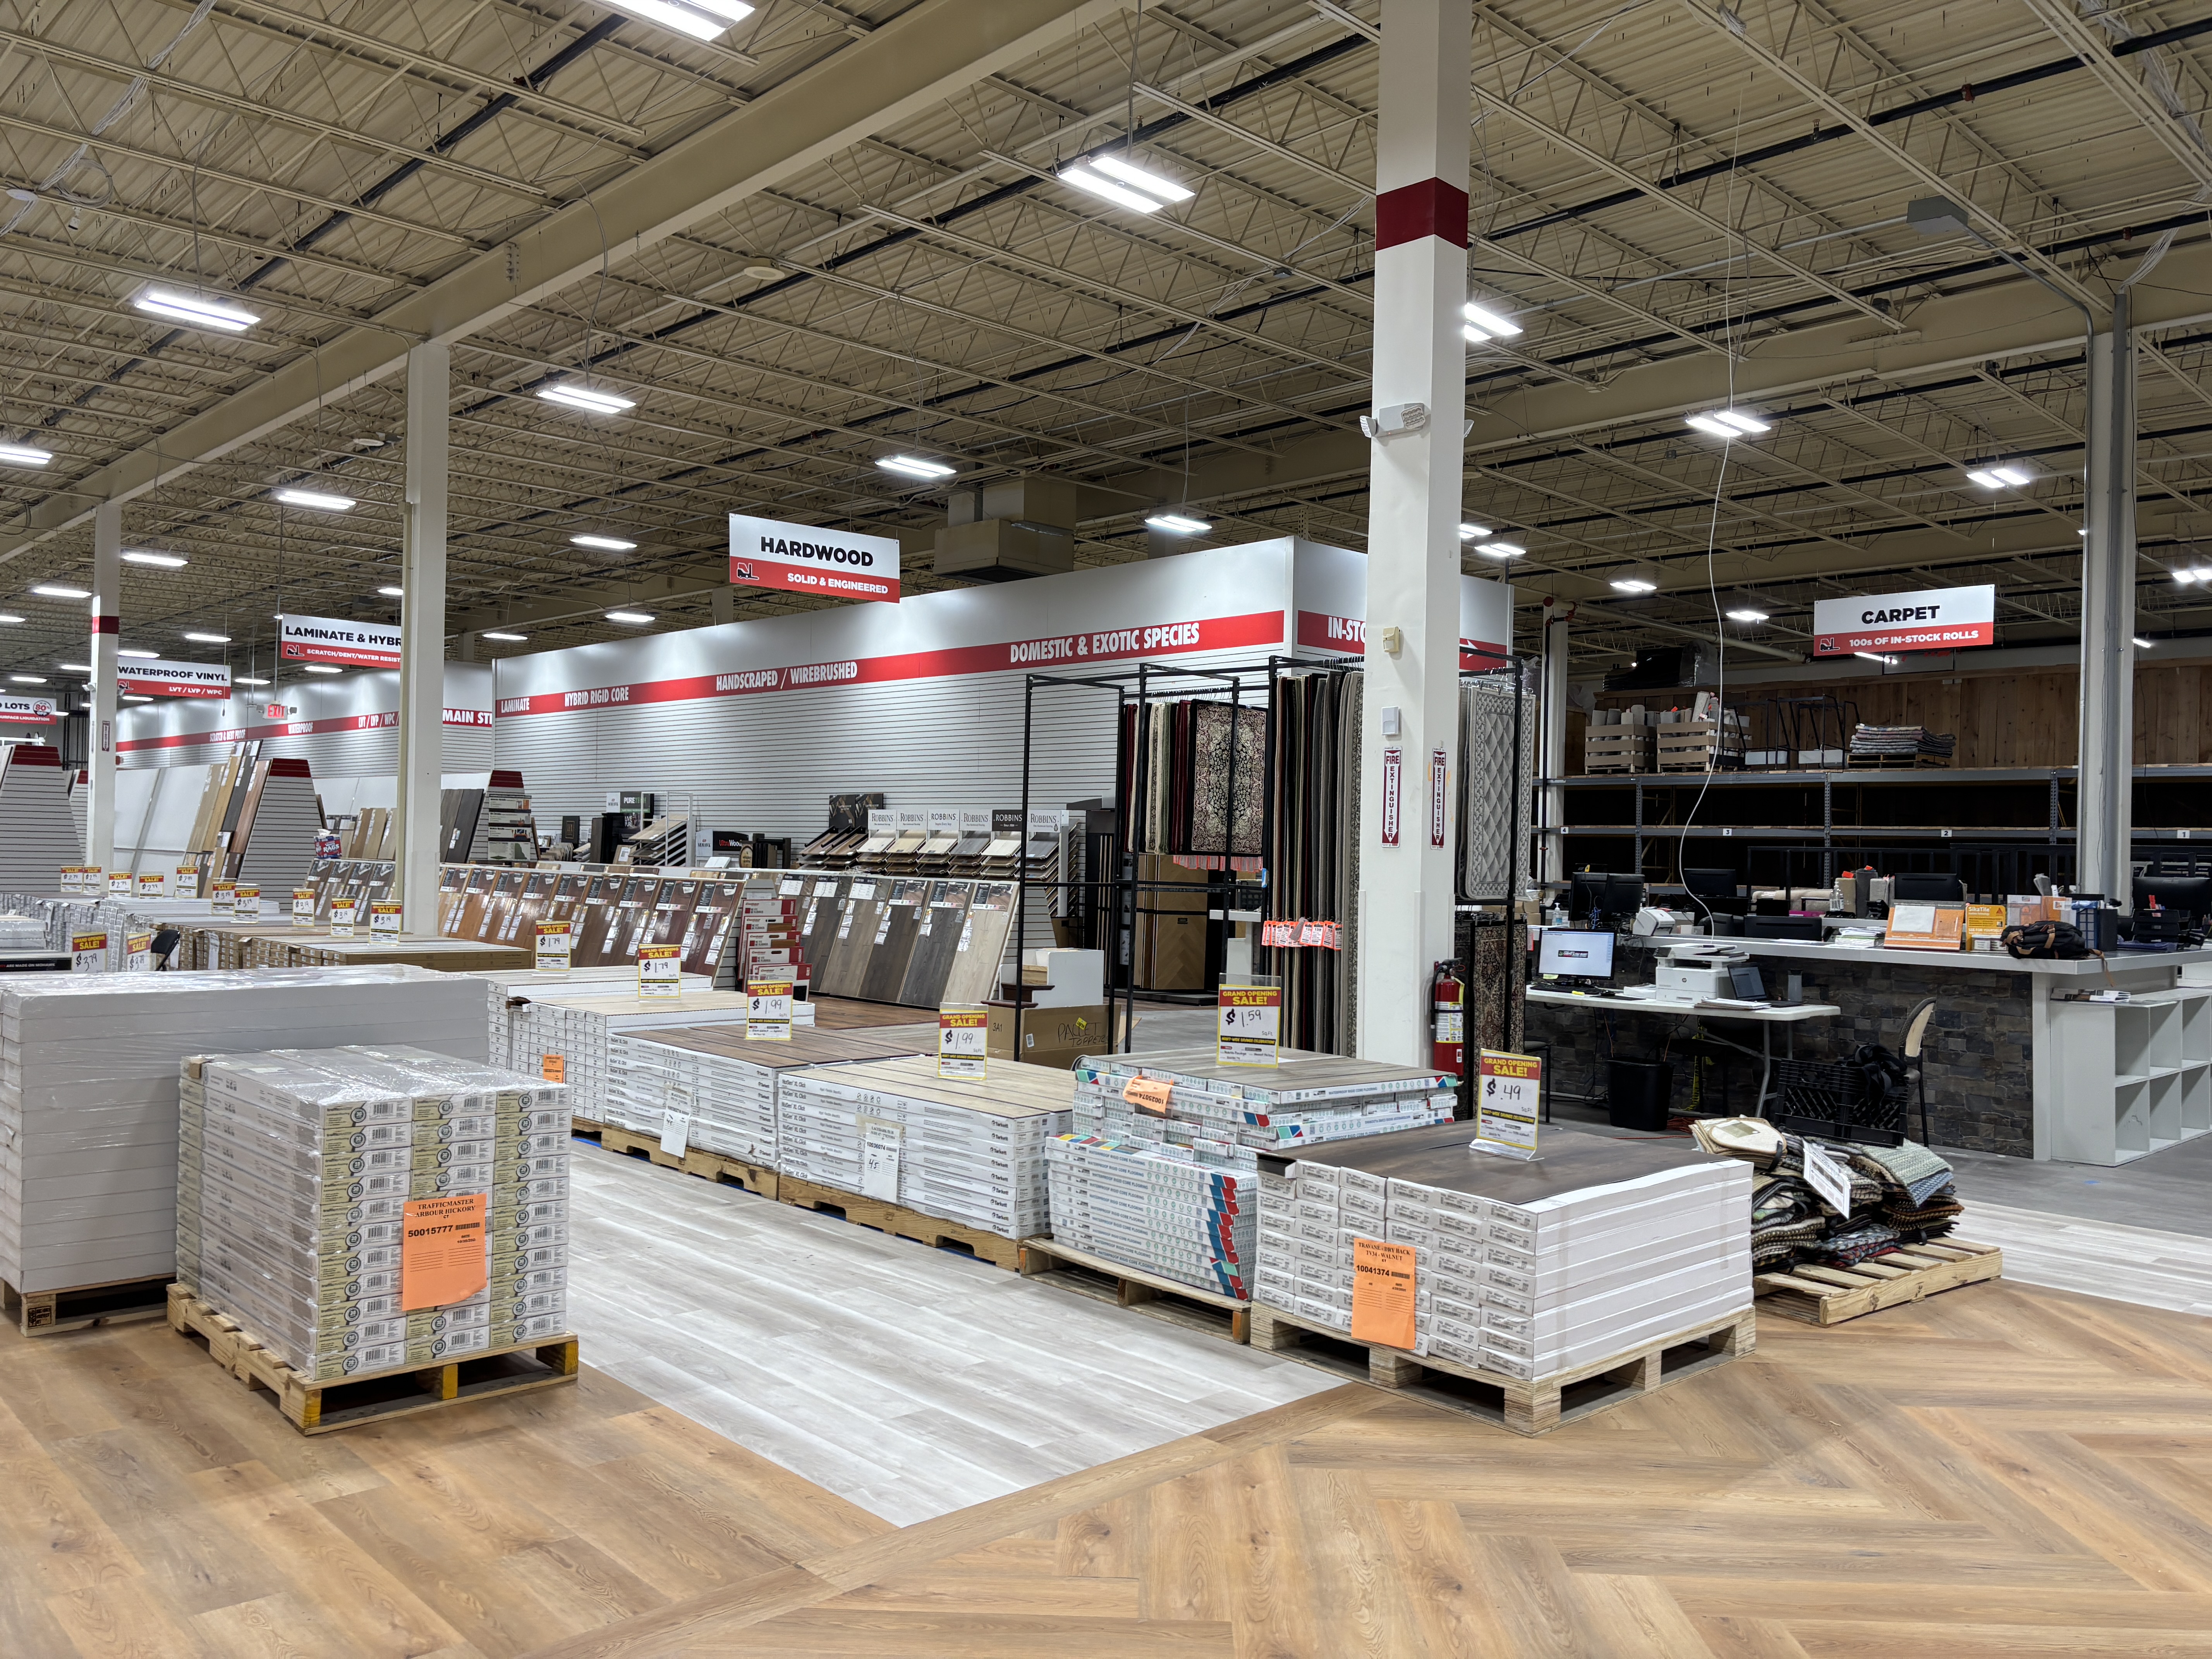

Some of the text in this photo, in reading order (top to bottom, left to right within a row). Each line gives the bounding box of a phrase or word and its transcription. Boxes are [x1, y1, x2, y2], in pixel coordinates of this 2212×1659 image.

[761, 537, 873, 566] HARDWOOD
[788, 573, 888, 594] SOLID & ENGINEERED
[1861, 605, 1940, 624] CARPET
[285, 626, 354, 642] LAMINATE
[357, 634, 365, 642] &
[1891, 634, 1941, 643] IN-STOCK
[1943, 630, 1979, 640] ROLLS
[1010, 622, 1199, 663] DOMESTIC & EXOTIC SPECIES
[307, 649, 379, 661] SCRATCH/DENT/WATER
[118, 666, 227, 681] WATERPROOF VINYL
[716, 661, 857, 691] HANDSCRAPED / WIREBRUSHED
[501, 686, 629, 713] LAMINATE HYBRID RIGID CORE
[268, 705, 285, 718] EXIT
[443, 709, 474, 723] MAIN
[288, 722, 313, 734] WATERPROOF
[1386, 756, 1400, 764] FIRE
[1434, 756, 1444, 766] FIRE
[964, 813, 988, 822] ROBBINS
[1030, 814, 1056, 823] ROBBINS
[374, 915, 379, 923] $
[79, 941, 100, 950] SALE!
[540, 936, 546, 946] $
[76, 953, 81, 967] $
[643, 960, 651, 972] $
[752, 998, 760, 1011] $
[1233, 996, 1267, 1005] SALE!
[1225, 1008, 1236, 1025] $
[945, 1029, 953, 1044] $
[1508, 1060, 1537, 1068] OPENING
[1493, 1065, 1527, 1077] SALE!
[1486, 1078, 1496, 1097] $
[1139, 1093, 1164, 1104] 10025074
[417, 1199, 474, 1209] TRAFFICMASTER
[416, 1206, 476, 1218] ARBOUR HICKORY
[408, 1224, 453, 1237] 50015777
[1358, 1242, 1381, 1251] TRAVANE
[1381, 1252, 1403, 1261] WALNUT
[1356, 1264, 1389, 1277] 10041374
